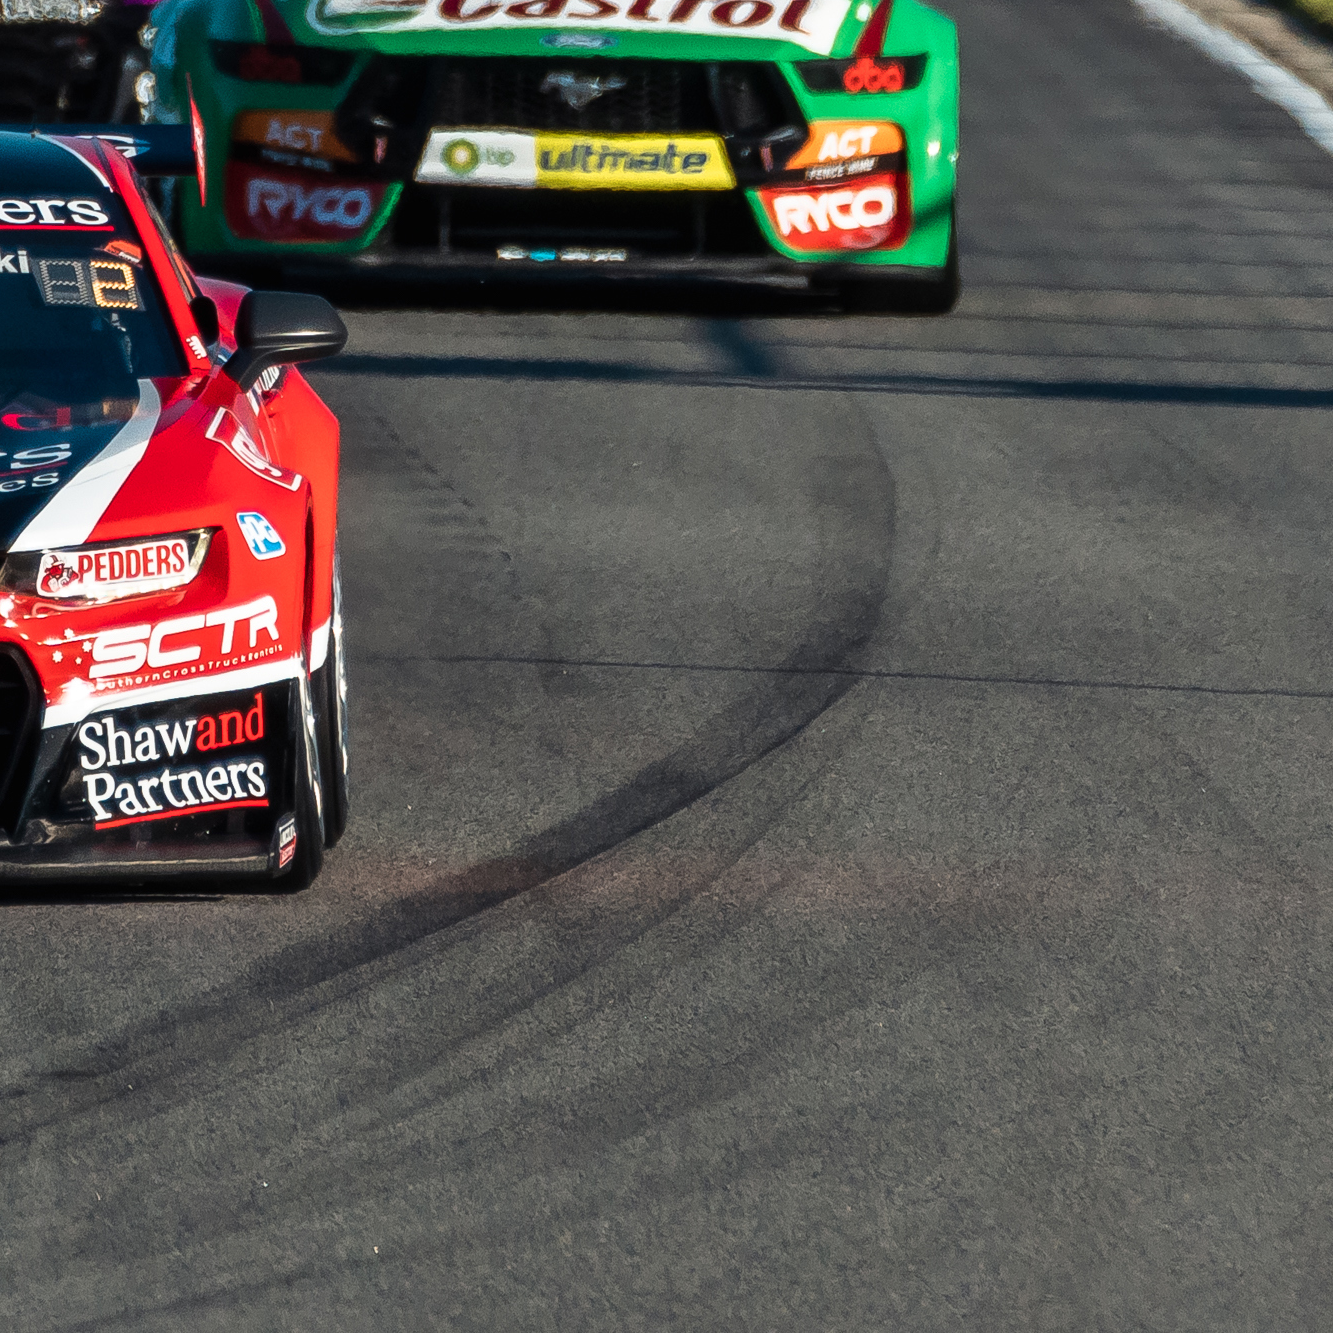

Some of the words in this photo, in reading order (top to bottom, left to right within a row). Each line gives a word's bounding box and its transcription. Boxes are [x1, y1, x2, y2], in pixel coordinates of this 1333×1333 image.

[539, 141, 708, 174] ultimate
[817, 125, 879, 162] ACT
[247, 177, 372, 229] RYCO
[773, 185, 897, 237] RYCO
[78, 542, 187, 584] PEDDERS
[88, 595, 280, 679] SCTR
[82, 760, 268, 822] Partners
